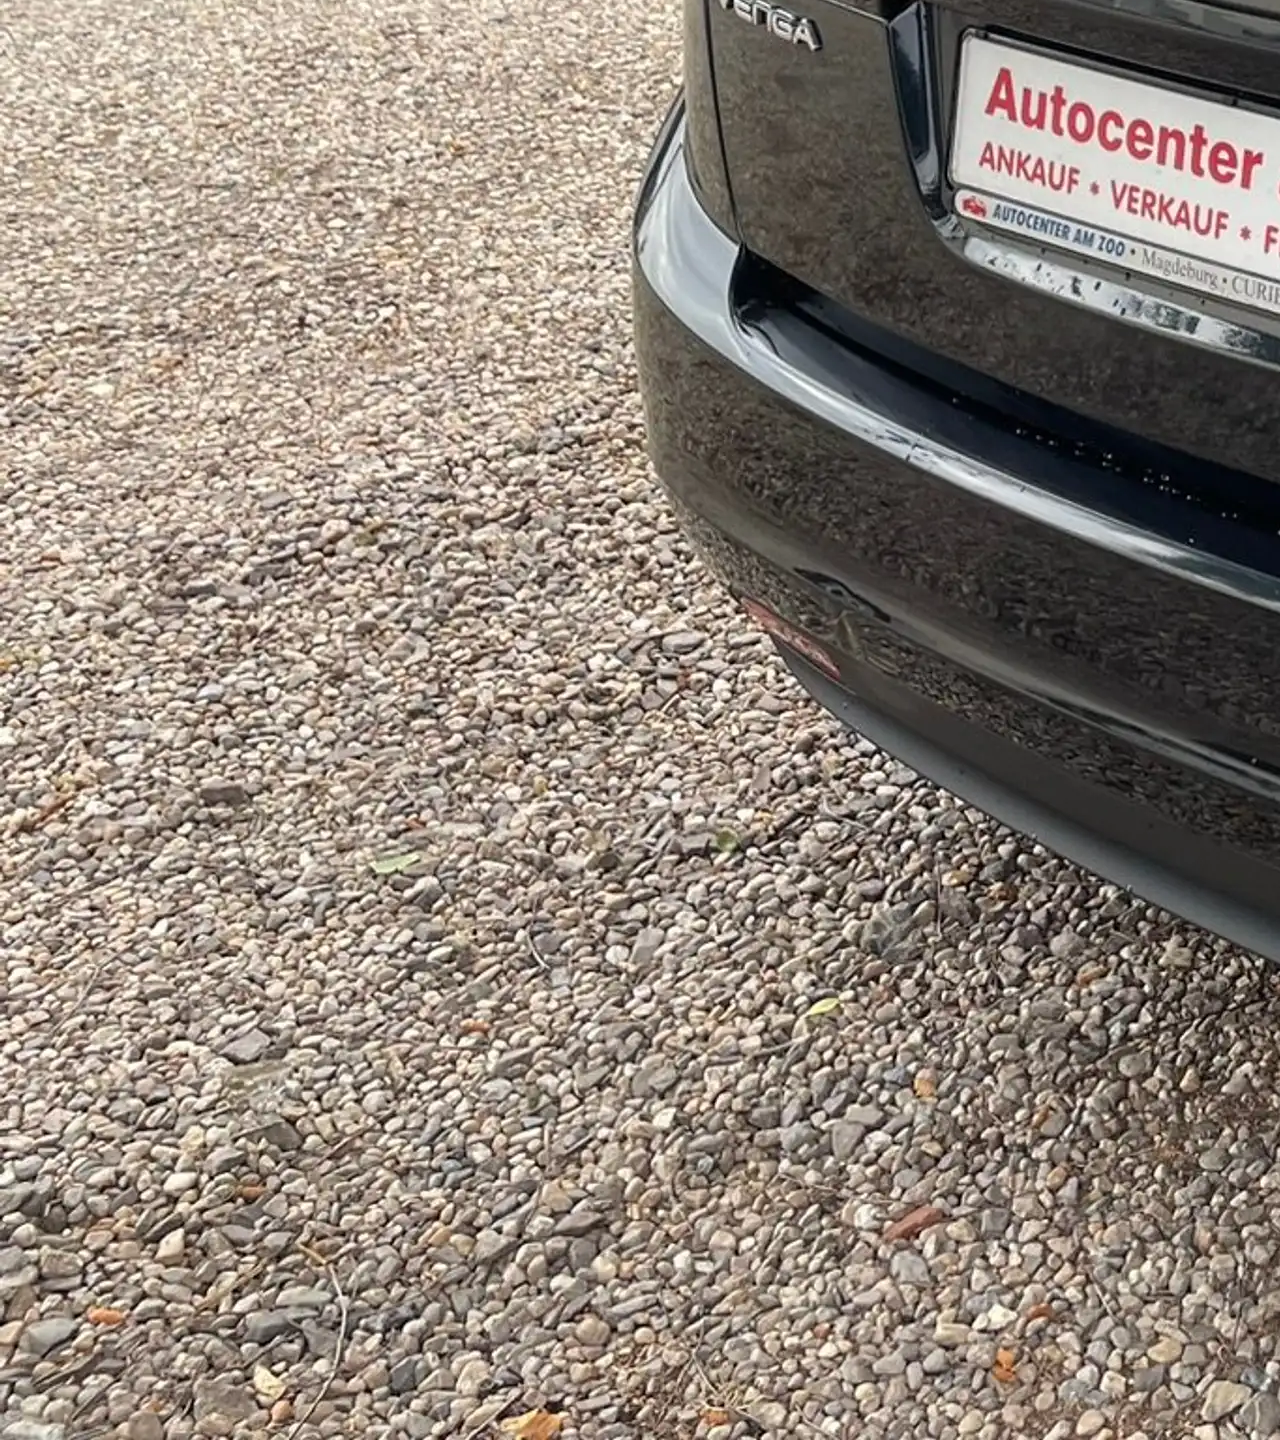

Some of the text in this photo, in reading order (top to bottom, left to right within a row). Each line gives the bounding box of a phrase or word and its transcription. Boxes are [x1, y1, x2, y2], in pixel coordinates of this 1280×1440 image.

[984, 65, 1264, 191] Autocenter
[978, 140, 1081, 196] ANKAUF
[1110, 179, 1229, 240] VERKAUF
[993, 203, 1070, 241] AUTOCENTER
[1071, 227, 1096, 248] AM
[1097, 235, 1126, 258] ZOO
[1142, 247, 1218, 289] Magdeburg
